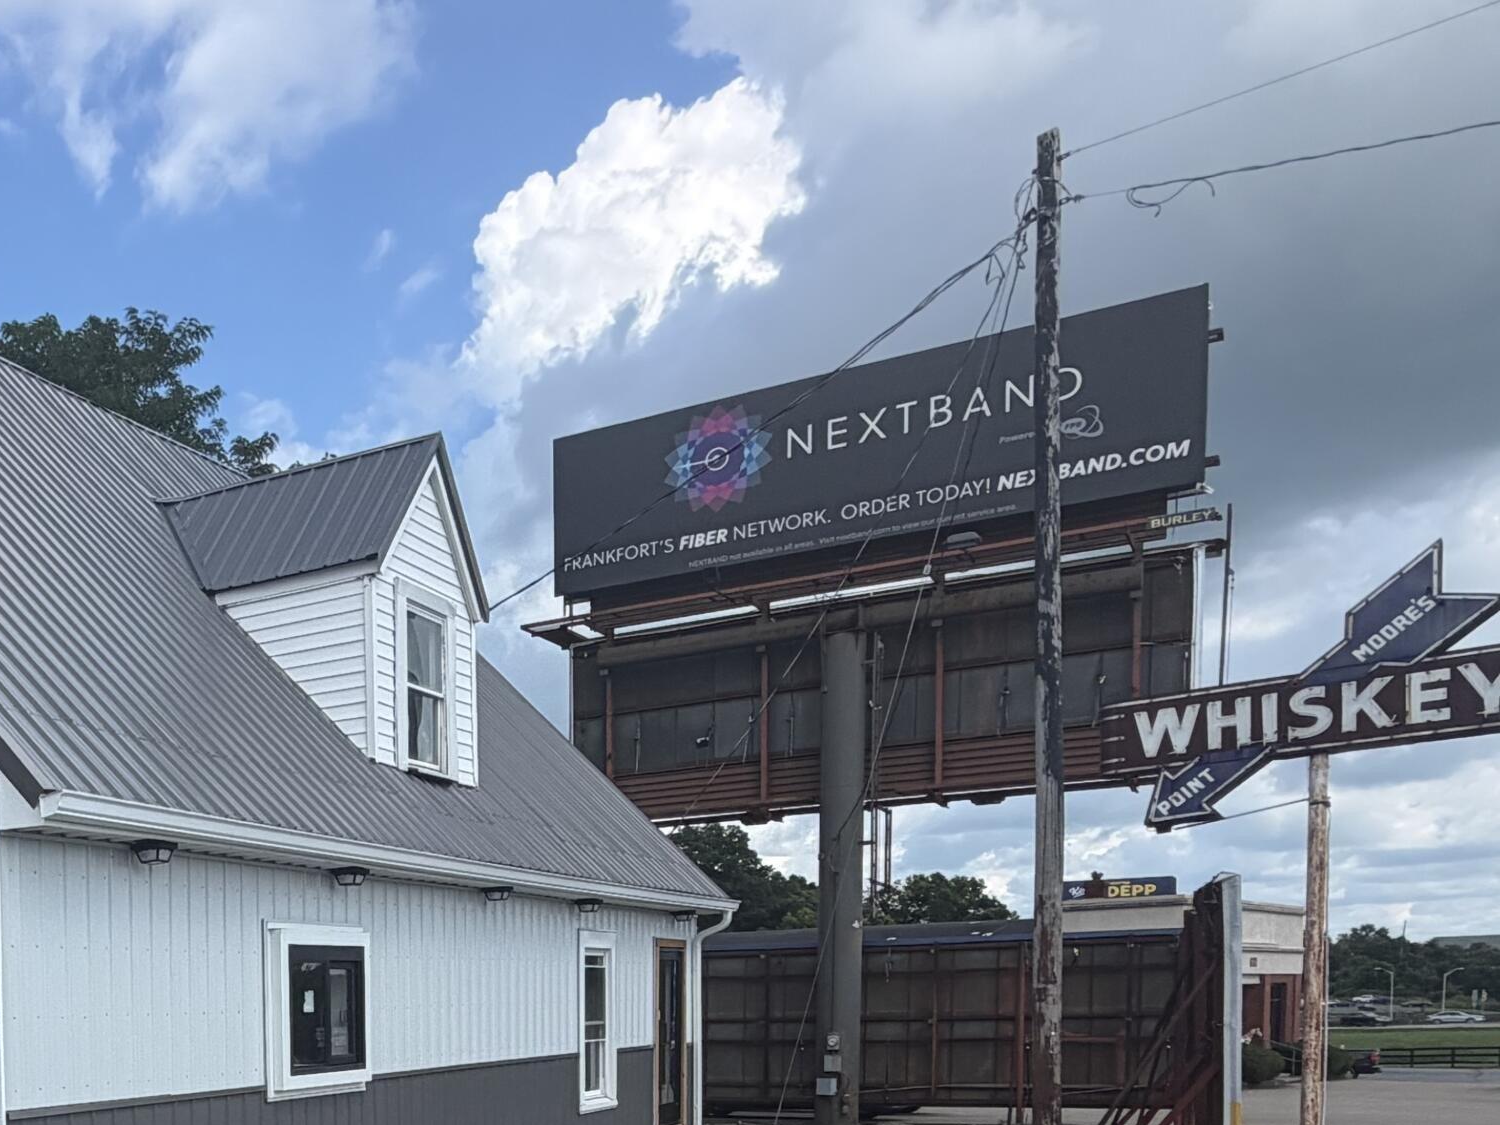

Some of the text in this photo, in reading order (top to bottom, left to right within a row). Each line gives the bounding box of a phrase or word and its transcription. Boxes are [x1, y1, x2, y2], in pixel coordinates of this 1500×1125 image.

[786, 367, 1083, 459] NEXTBAND
[564, 439, 1192, 572] FRANKFORT'S FIBER NETWORK. ORDER TODAY! NEXBAND.COM
[1151, 511, 1211, 528] BURLEY
[1351, 595, 1437, 663] MOORE'S
[1133, 662, 1500, 759] WHISKEY
[1156, 767, 1215, 816] POINT
[1107, 883, 1157, 898] DEPP
